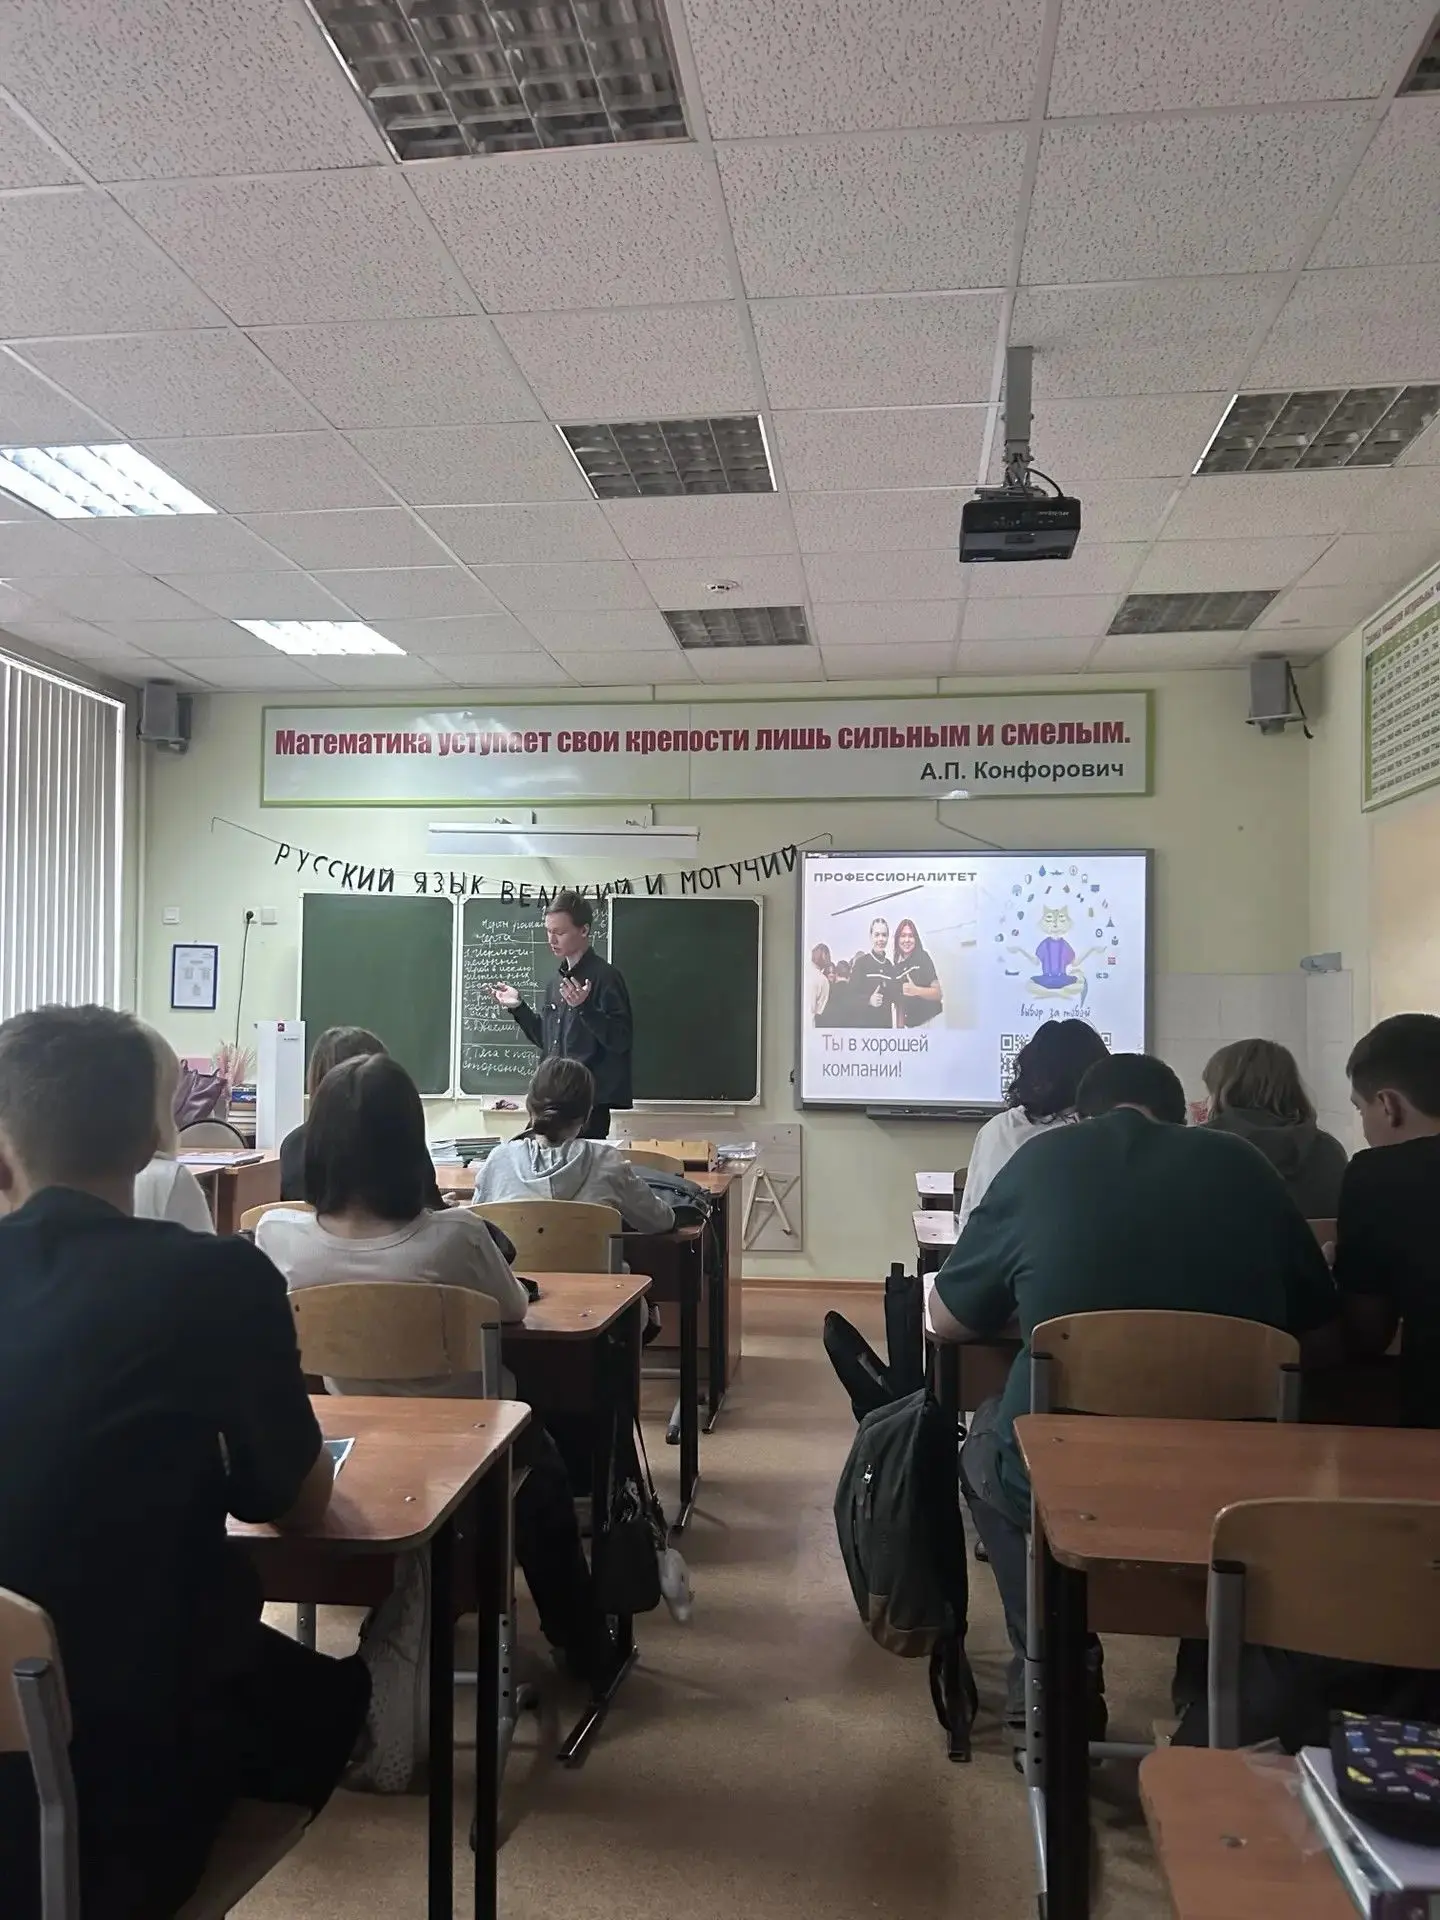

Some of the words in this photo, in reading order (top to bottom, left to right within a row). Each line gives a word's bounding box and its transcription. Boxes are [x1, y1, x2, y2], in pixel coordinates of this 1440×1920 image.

[275, 729, 432, 755] Математика
[437, 730, 552, 757] уступает
[557, 729, 619, 753] свои
[625, 727, 750, 755] крепости
[755, 727, 831, 752] лишь
[837, 724, 970, 750] сильным
[977, 724, 994, 747] и
[1001, 721, 1131, 746] смелым.
[920, 761, 966, 780] А.П.
[974, 760, 1124, 782] Конфорович
[274, 843, 395, 893] РУССКИЙ
[414, 871, 484, 895] ЯЗЫК
[645, 874, 663, 895] И
[681, 844, 799, 894] МОГУЧИЙ
[813, 872, 977, 883] ПРОФЕССИОНАЛИТЕТ
[822, 1034, 844, 1051] Ты
[848, 1038, 857, 1051] в
[861, 1034, 929, 1055] хорошей
[822, 1060, 902, 1077] компании!
